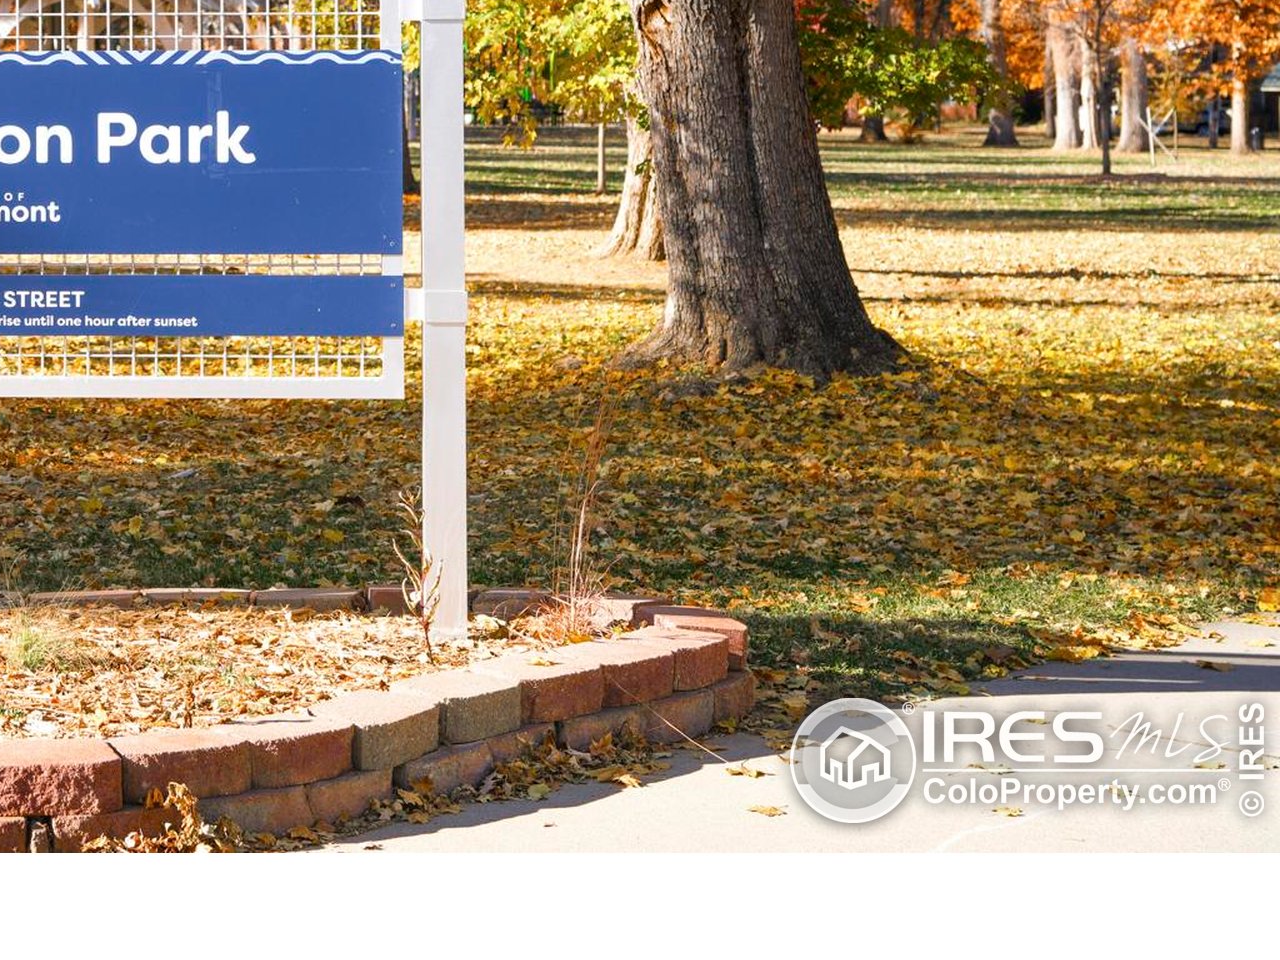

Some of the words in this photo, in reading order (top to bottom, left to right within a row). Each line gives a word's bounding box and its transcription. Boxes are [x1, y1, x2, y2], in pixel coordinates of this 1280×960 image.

[97, 110, 257, 165] Park
[3, 192, 25, 202] OF
[3, 290, 85, 308] STREET
[23, 314, 55, 327] until
[56, 317, 82, 327] one
[84, 314, 116, 327] hour
[117, 314, 152, 327] after
[153, 315, 198, 327] sunset
